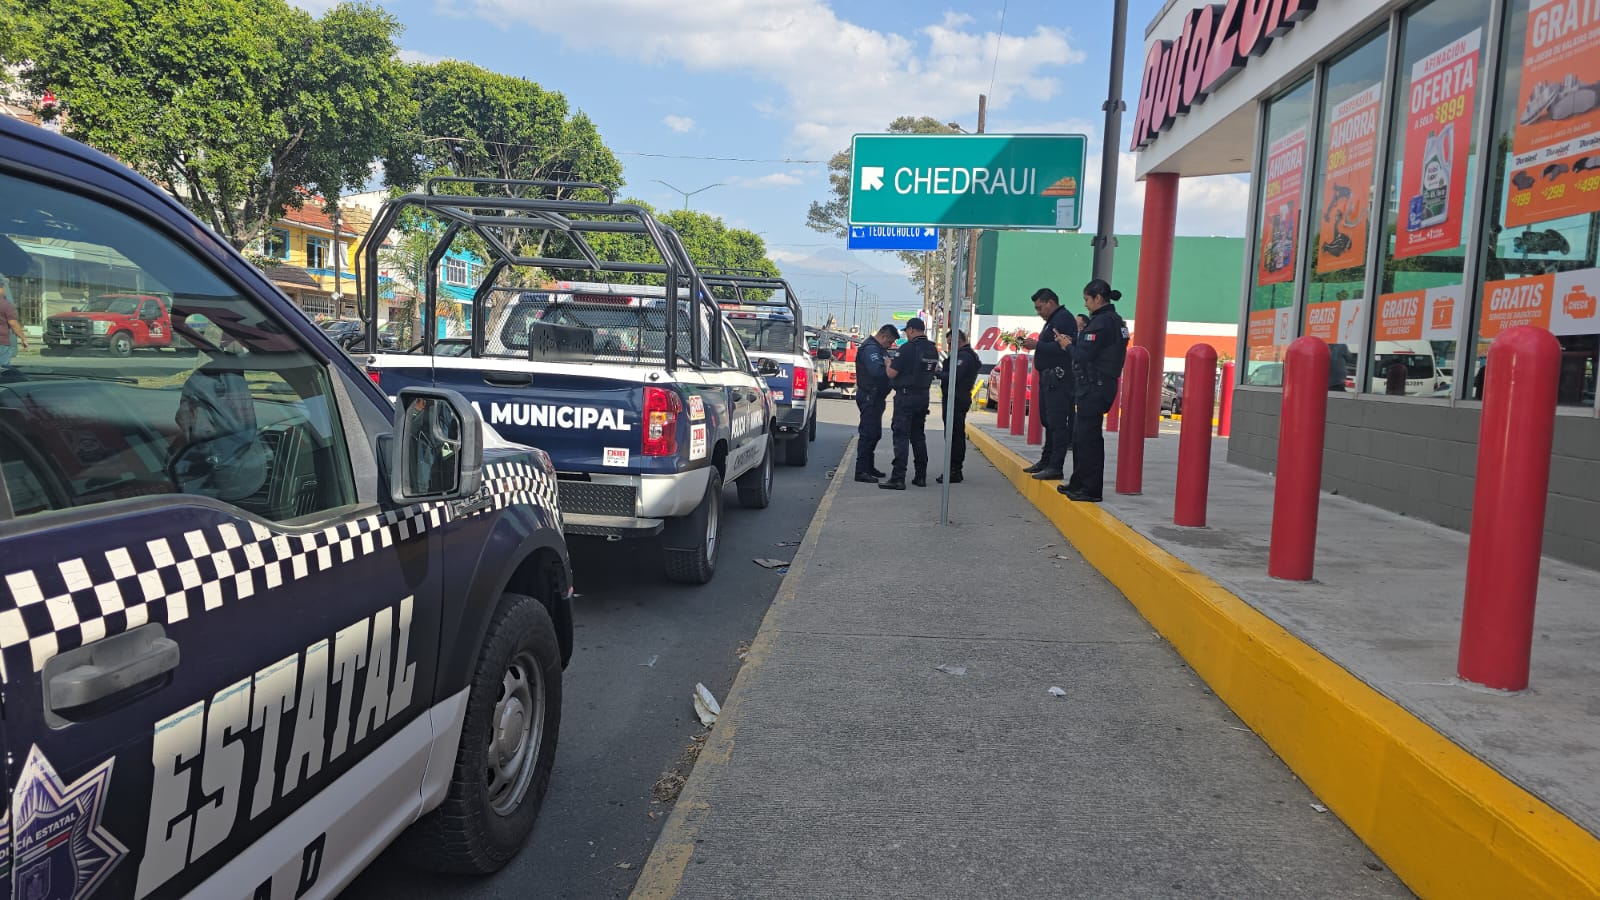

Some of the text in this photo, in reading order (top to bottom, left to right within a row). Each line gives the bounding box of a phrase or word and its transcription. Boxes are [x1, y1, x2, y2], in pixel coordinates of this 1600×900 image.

[1411, 58, 1473, 114] OFERTA
[1435, 94, 1465, 124] $899
[1331, 107, 1376, 149] AHORRA
[1269, 145, 1302, 181] AHORRA
[894, 166, 1036, 195] CHEDRAUI
[1382, 296, 1419, 319] GRATIS
[1490, 283, 1545, 311] GRATIS
[1309, 307, 1336, 325] GRATIS
[491, 402, 631, 431] MUNICIPAL
[135, 595, 417, 900] ESTATAL
[35, 812, 77, 841] ESTATAL
